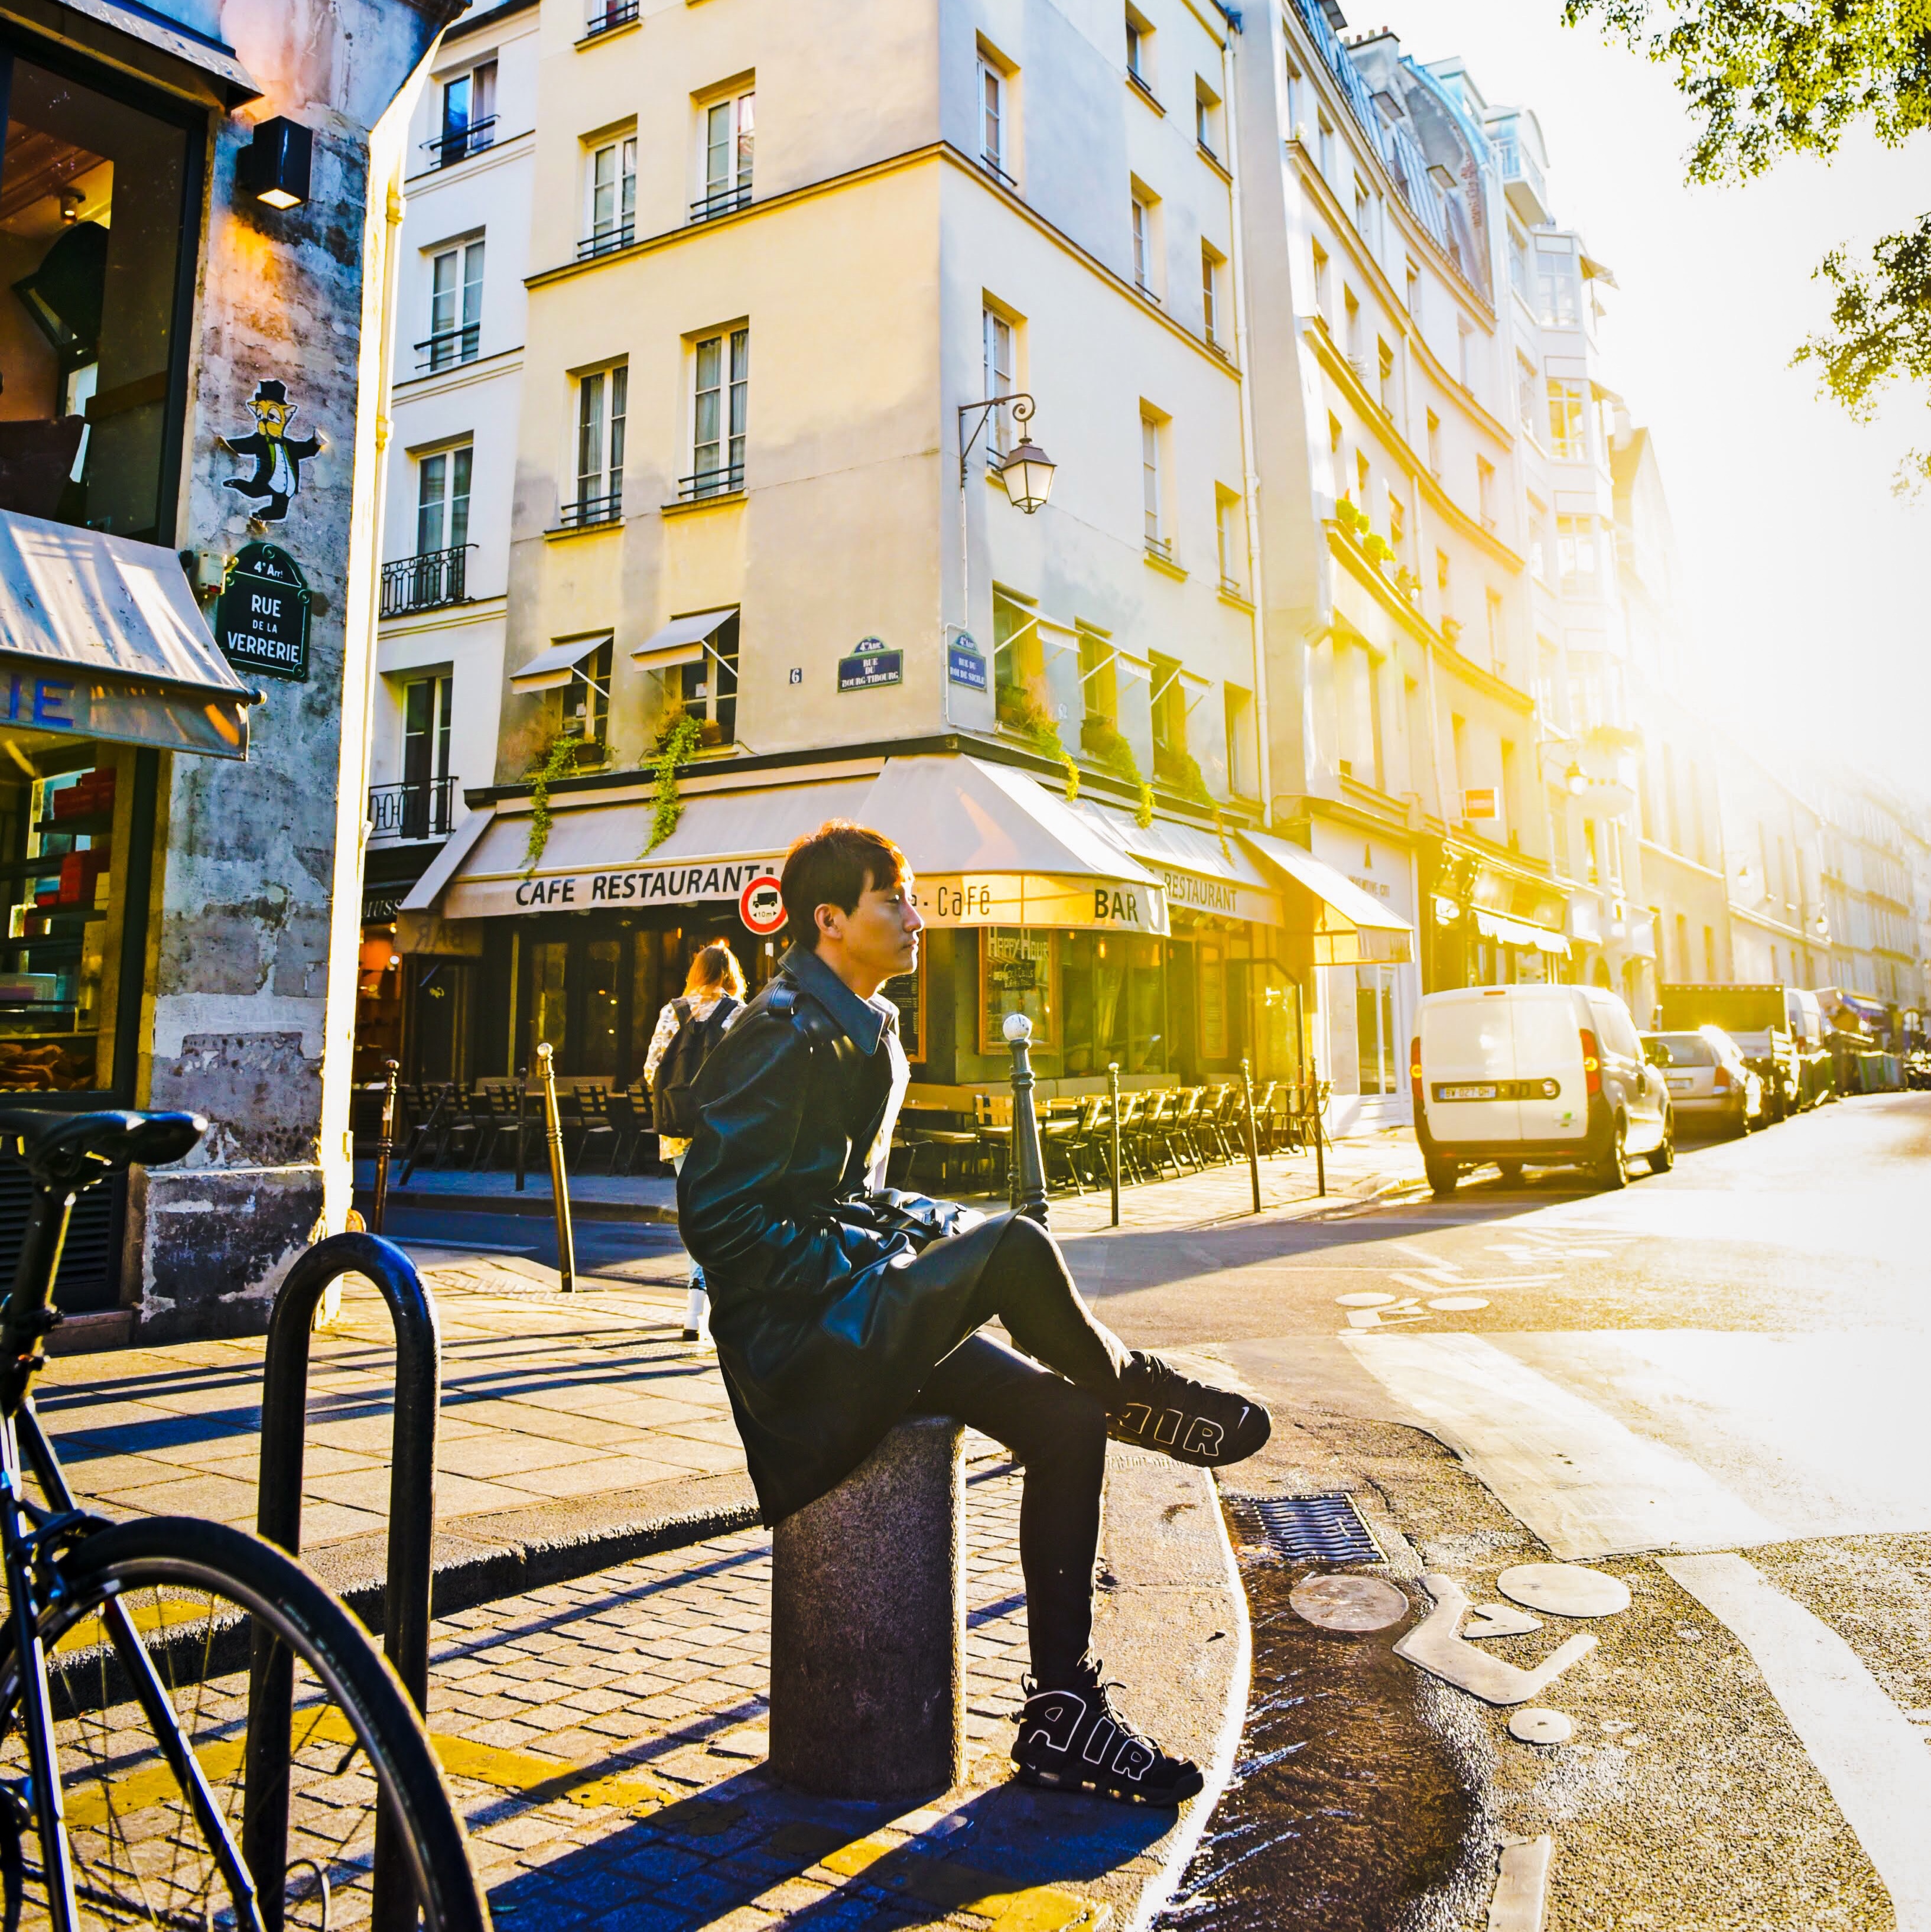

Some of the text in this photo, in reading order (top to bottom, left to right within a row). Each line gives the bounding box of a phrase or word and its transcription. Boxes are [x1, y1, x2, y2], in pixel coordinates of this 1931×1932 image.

[252, 595, 281, 617] RUE
[252, 619, 278, 634] DE LA
[227, 631, 300, 663] VERRERIE
[863, 658, 878, 667] RUE
[865, 666, 875, 675] DU
[950, 667, 960, 677] ROI
[960, 670, 967, 679] DE
[792, 668, 800, 683] 6
[516, 865, 760, 906] CAFE RESTAURANT
[1164, 872, 1237, 912] RESTAURANT
[1094, 888, 1139, 923] BAR
[1023, 1690, 1155, 1781] AIR
